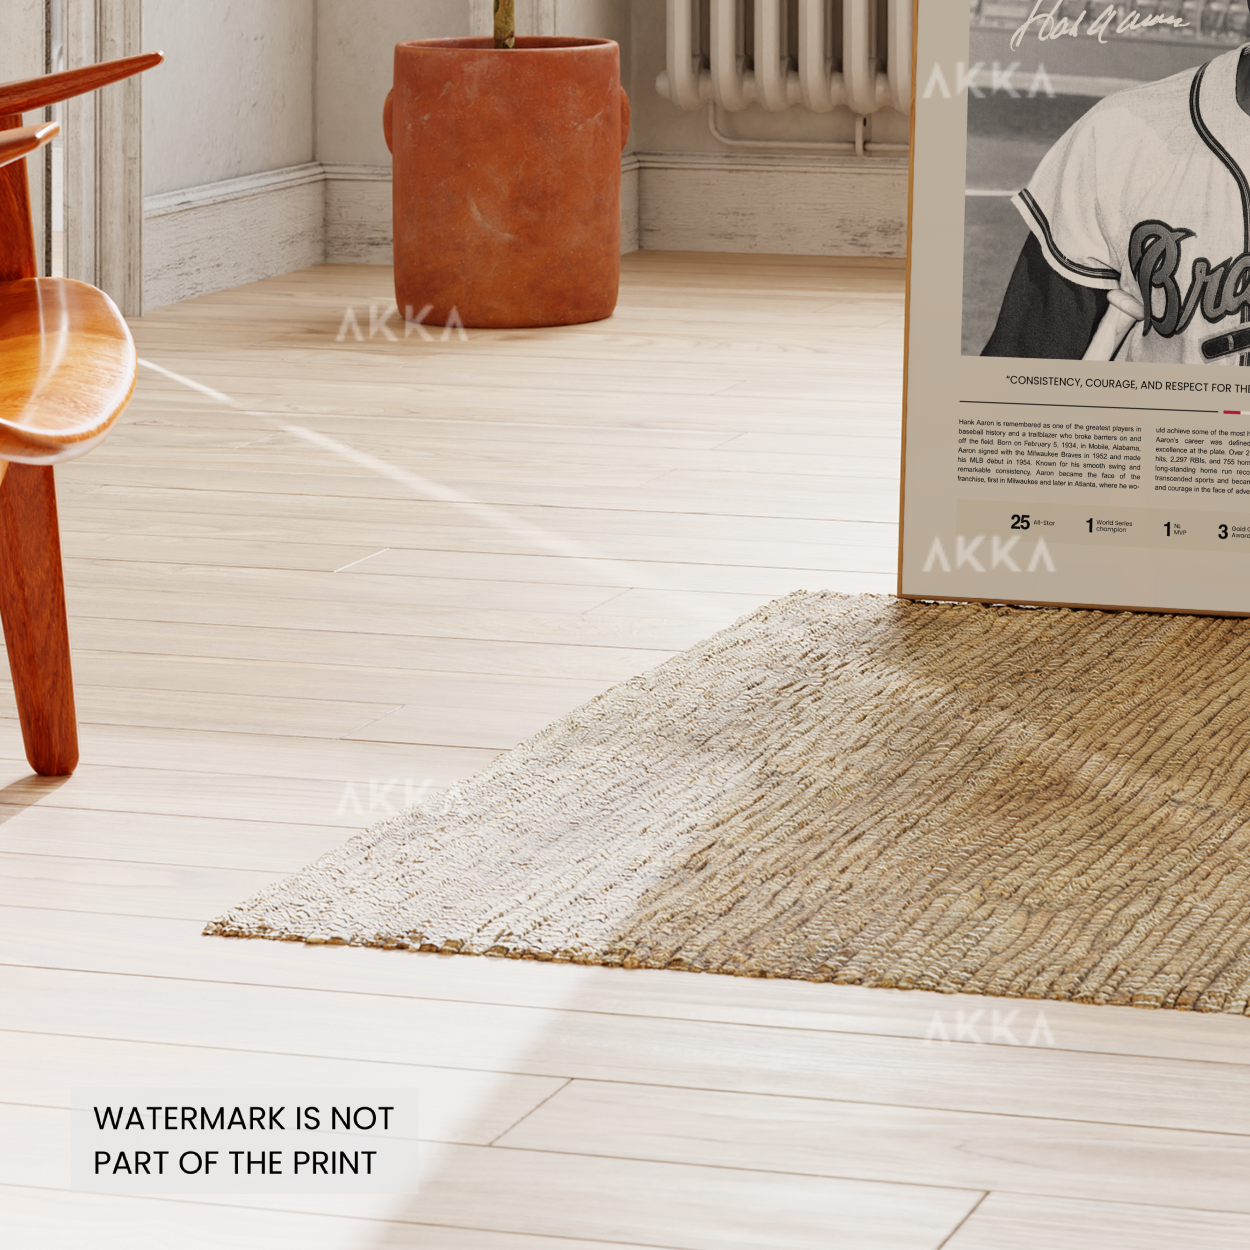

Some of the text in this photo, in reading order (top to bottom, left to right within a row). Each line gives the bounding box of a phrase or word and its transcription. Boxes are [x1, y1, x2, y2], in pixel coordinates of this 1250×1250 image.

[1085, 378, 1138, 391] COURAGE,
[1140, 380, 1163, 390] AND
[1165, 381, 1209, 392] RESPECT
[1212, 383, 1232, 393] FOR
[980, 438, 995, 446] field.
[1024, 440, 1052, 449] February
[1053, 441, 1059, 449] 5,
[1062, 442, 1079, 450] 1934,
[1088, 443, 1111, 451] Mobile,
[1112, 444, 1141, 452] Alabama,
[1190, 457, 1207, 465] RBIs,
[1223, 458, 1236, 466] 755
[1010, 514, 1031, 531] 25
[1033, 519, 1056, 527] All-Star
[1086, 517, 1093, 533] 1
[1096, 526, 1127, 534] champion
[1164, 521, 1171, 537] 1
[1218, 524, 1229, 540] 3
